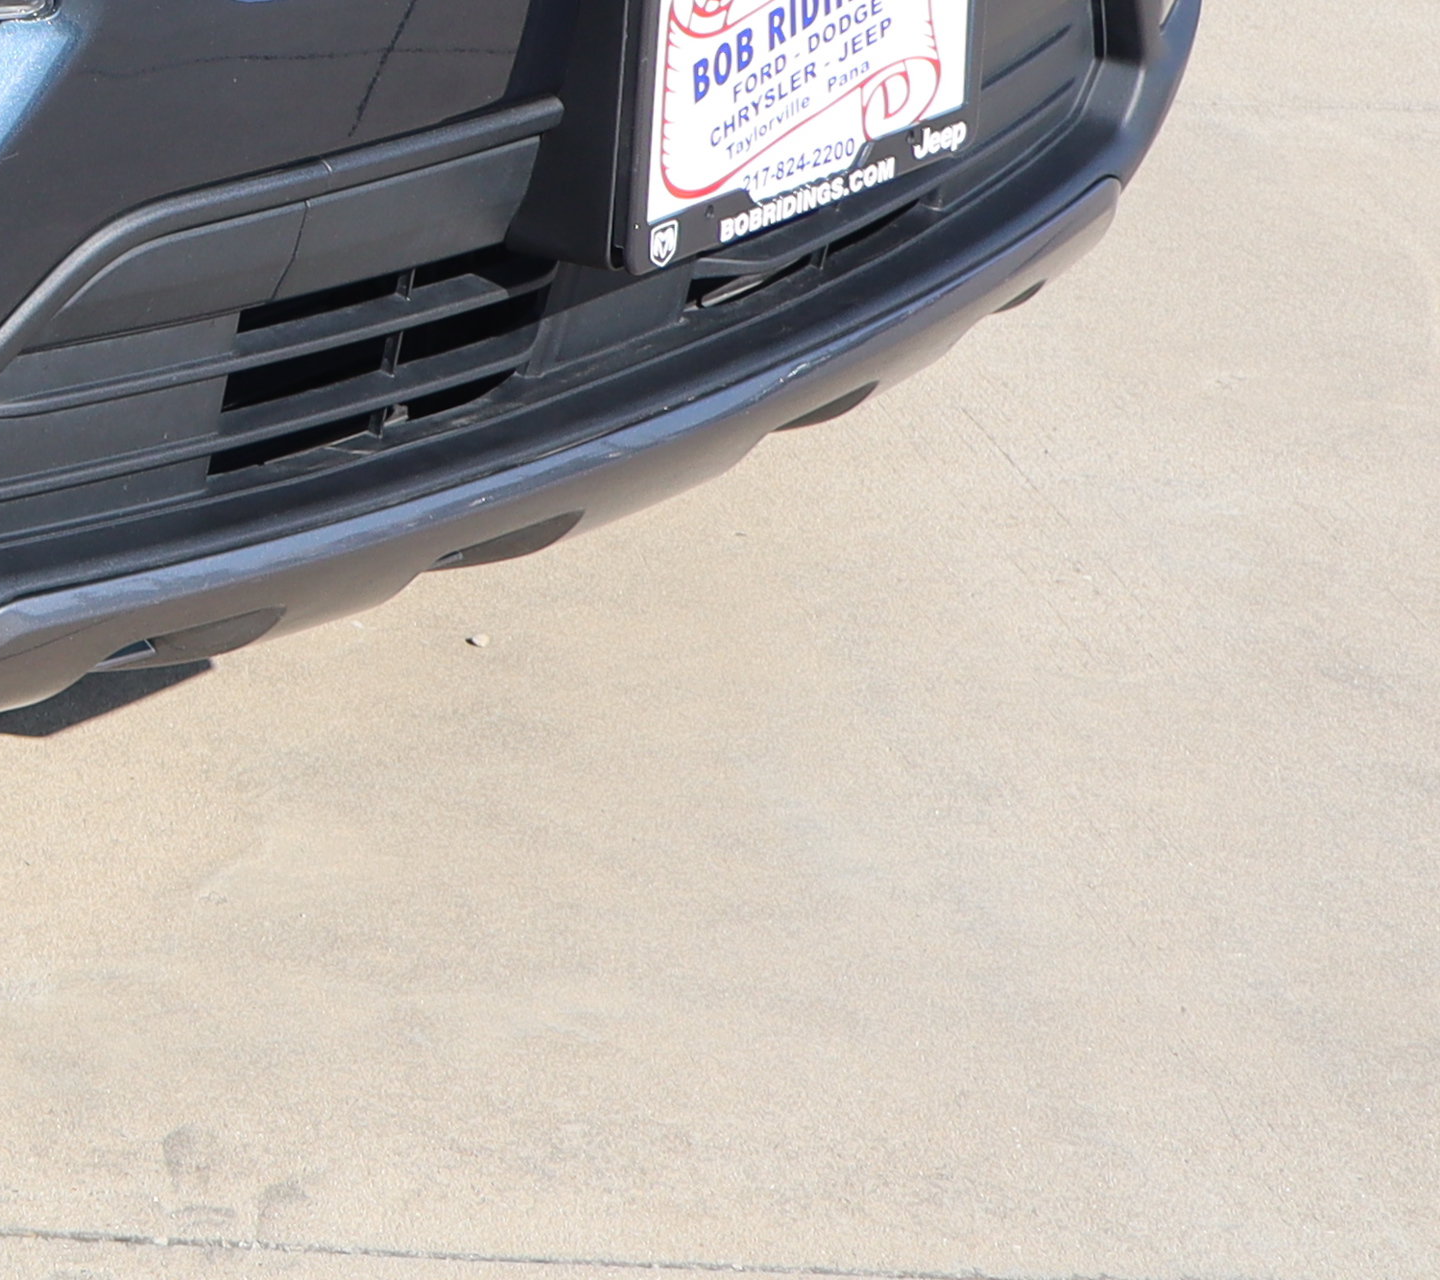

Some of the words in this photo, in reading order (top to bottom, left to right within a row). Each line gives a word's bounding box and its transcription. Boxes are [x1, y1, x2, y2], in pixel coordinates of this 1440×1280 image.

[693, 26, 755, 105] BOB
[710, 61, 817, 148] CHRYSLER
[838, 16, 892, 62] JEEP
[733, 53, 788, 104] FORD
[725, 96, 811, 161] Taylorville
[827, 60, 870, 93] Pana
[913, 120, 967, 161] Jeep
[719, 157, 897, 243] BOBRIDINGS.COM
[742, 137, 856, 192] 217-824-2200
